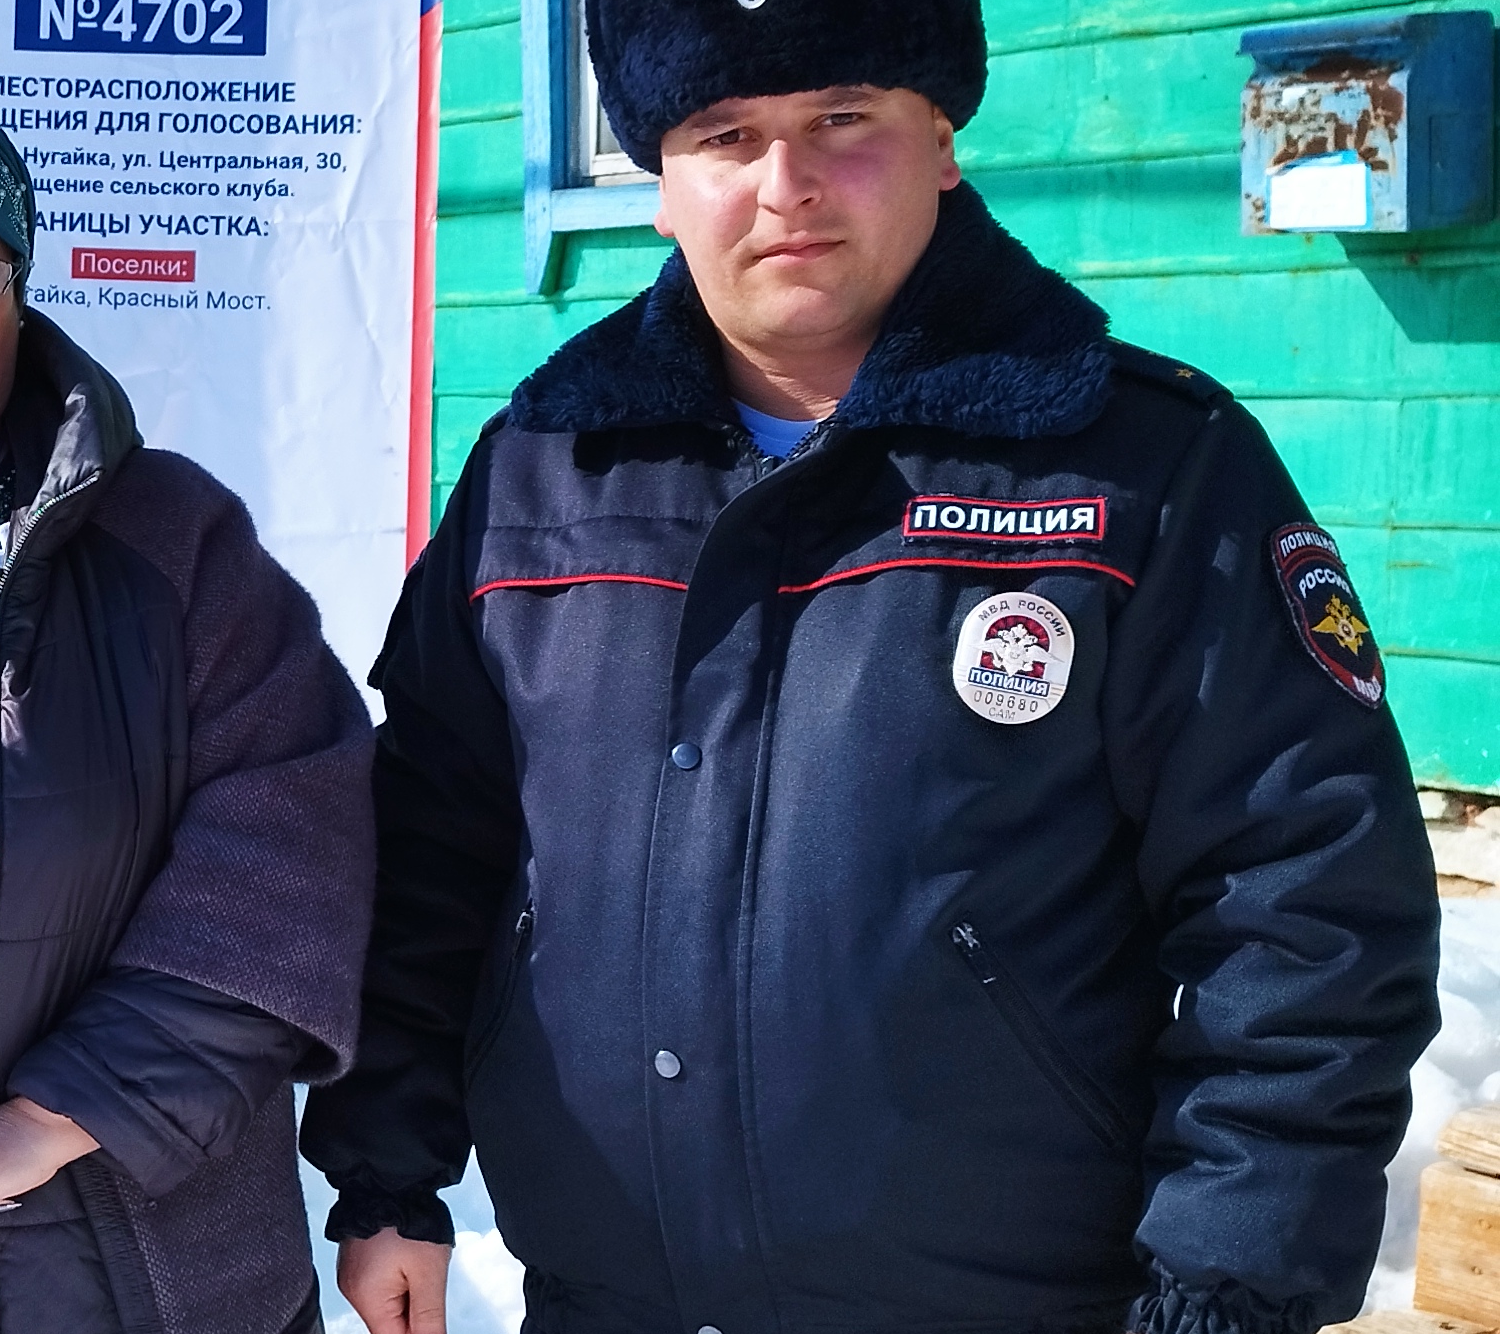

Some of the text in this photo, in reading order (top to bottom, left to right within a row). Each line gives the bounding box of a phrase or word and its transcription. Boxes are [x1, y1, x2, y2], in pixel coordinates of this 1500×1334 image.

[95, 111, 150, 135] ДЛЯ
[158, 113, 362, 134] ГОЛОСОВАНИЯ:
[23, 147, 347, 173] Нугайка, ул. Центральная, 30,
[34, 178, 295, 201] щение сельского клуба.
[35, 211, 269, 237] АНИЦЫ УЧАСТКА:
[80, 253, 188, 276] Поселки:
[25, 285, 271, 310] гайка, Красный Мост.
[914, 504, 1095, 534] ПОЛИЦИЯ
[1280, 531, 1338, 557] ПОЛИЦИЯ
[978, 599, 1066, 637] МВД РОССИИ
[970, 670, 1049, 695] ПОЛИЦИЯ
[974, 690, 1038, 713] 009680
